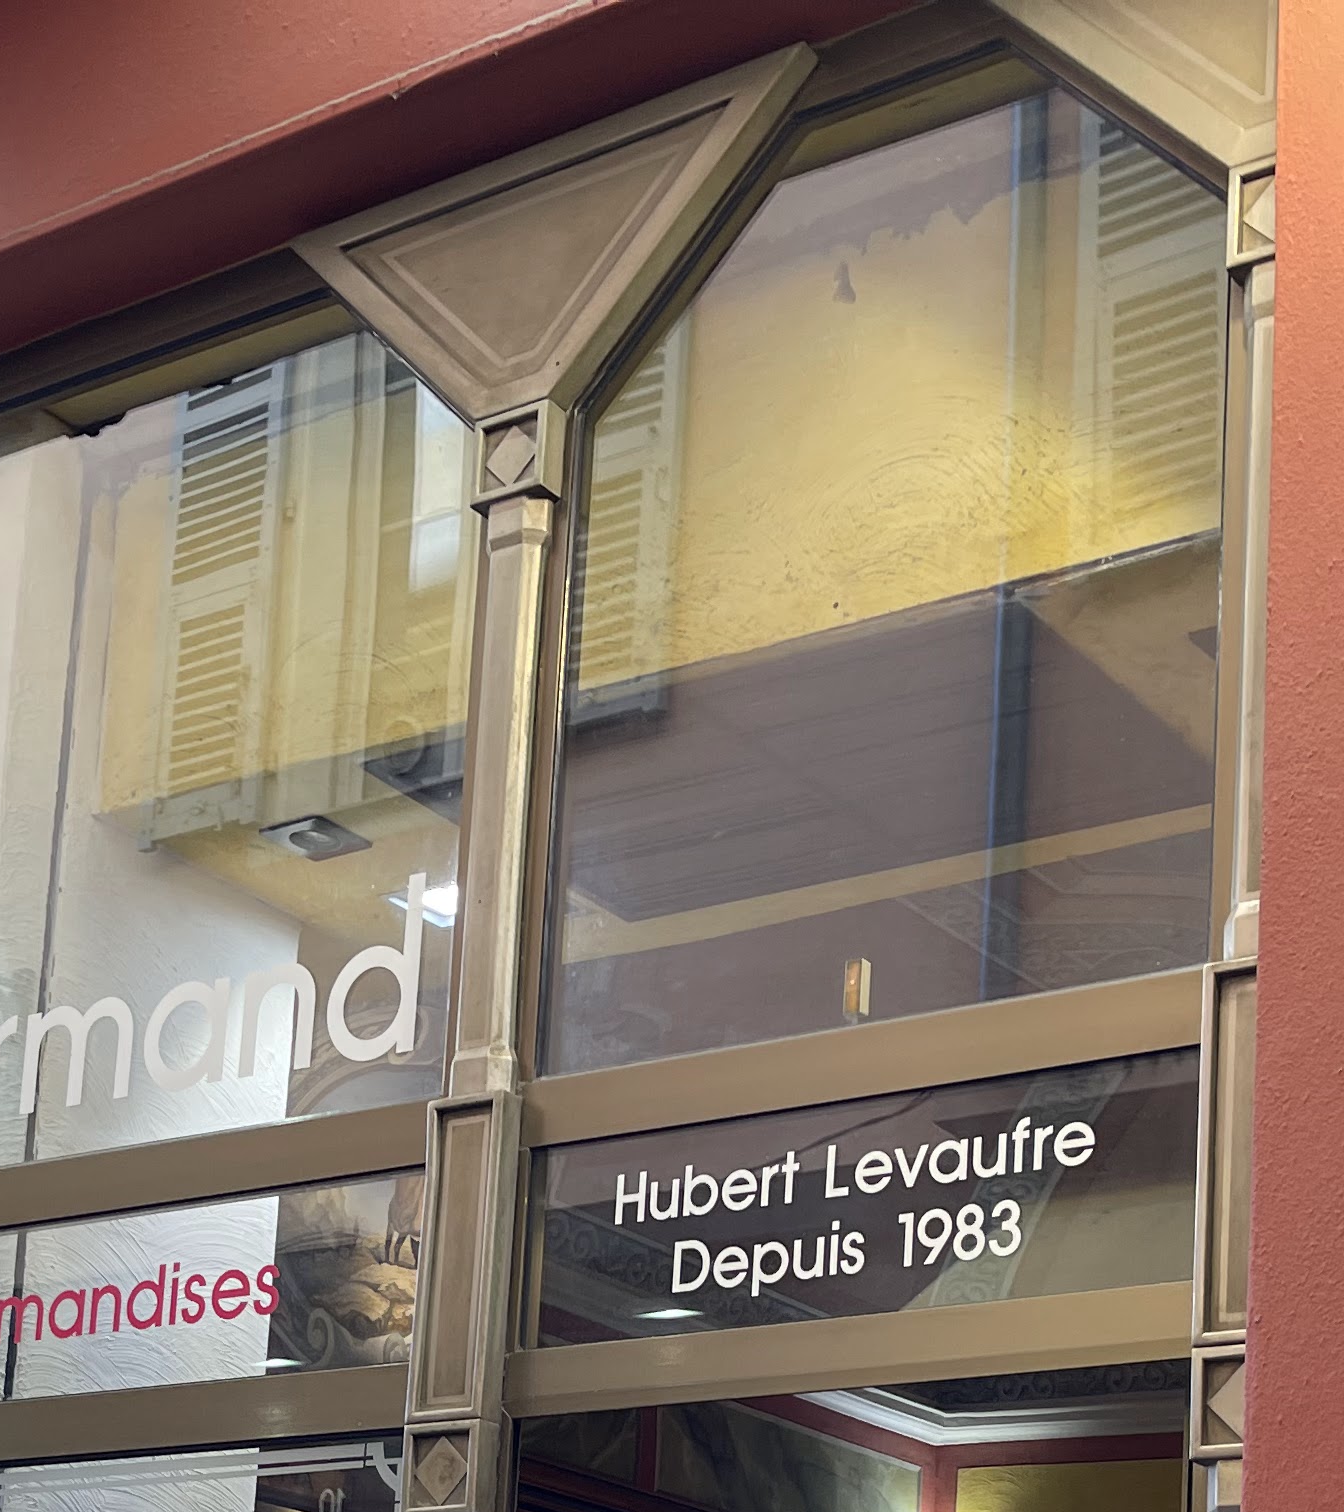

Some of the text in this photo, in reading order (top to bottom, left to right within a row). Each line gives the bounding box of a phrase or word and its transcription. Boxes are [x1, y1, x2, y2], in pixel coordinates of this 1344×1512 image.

[613, 1115, 1097, 1226] Hubert Levaufre
[671, 1199, 1023, 1297] Depuis 1983
